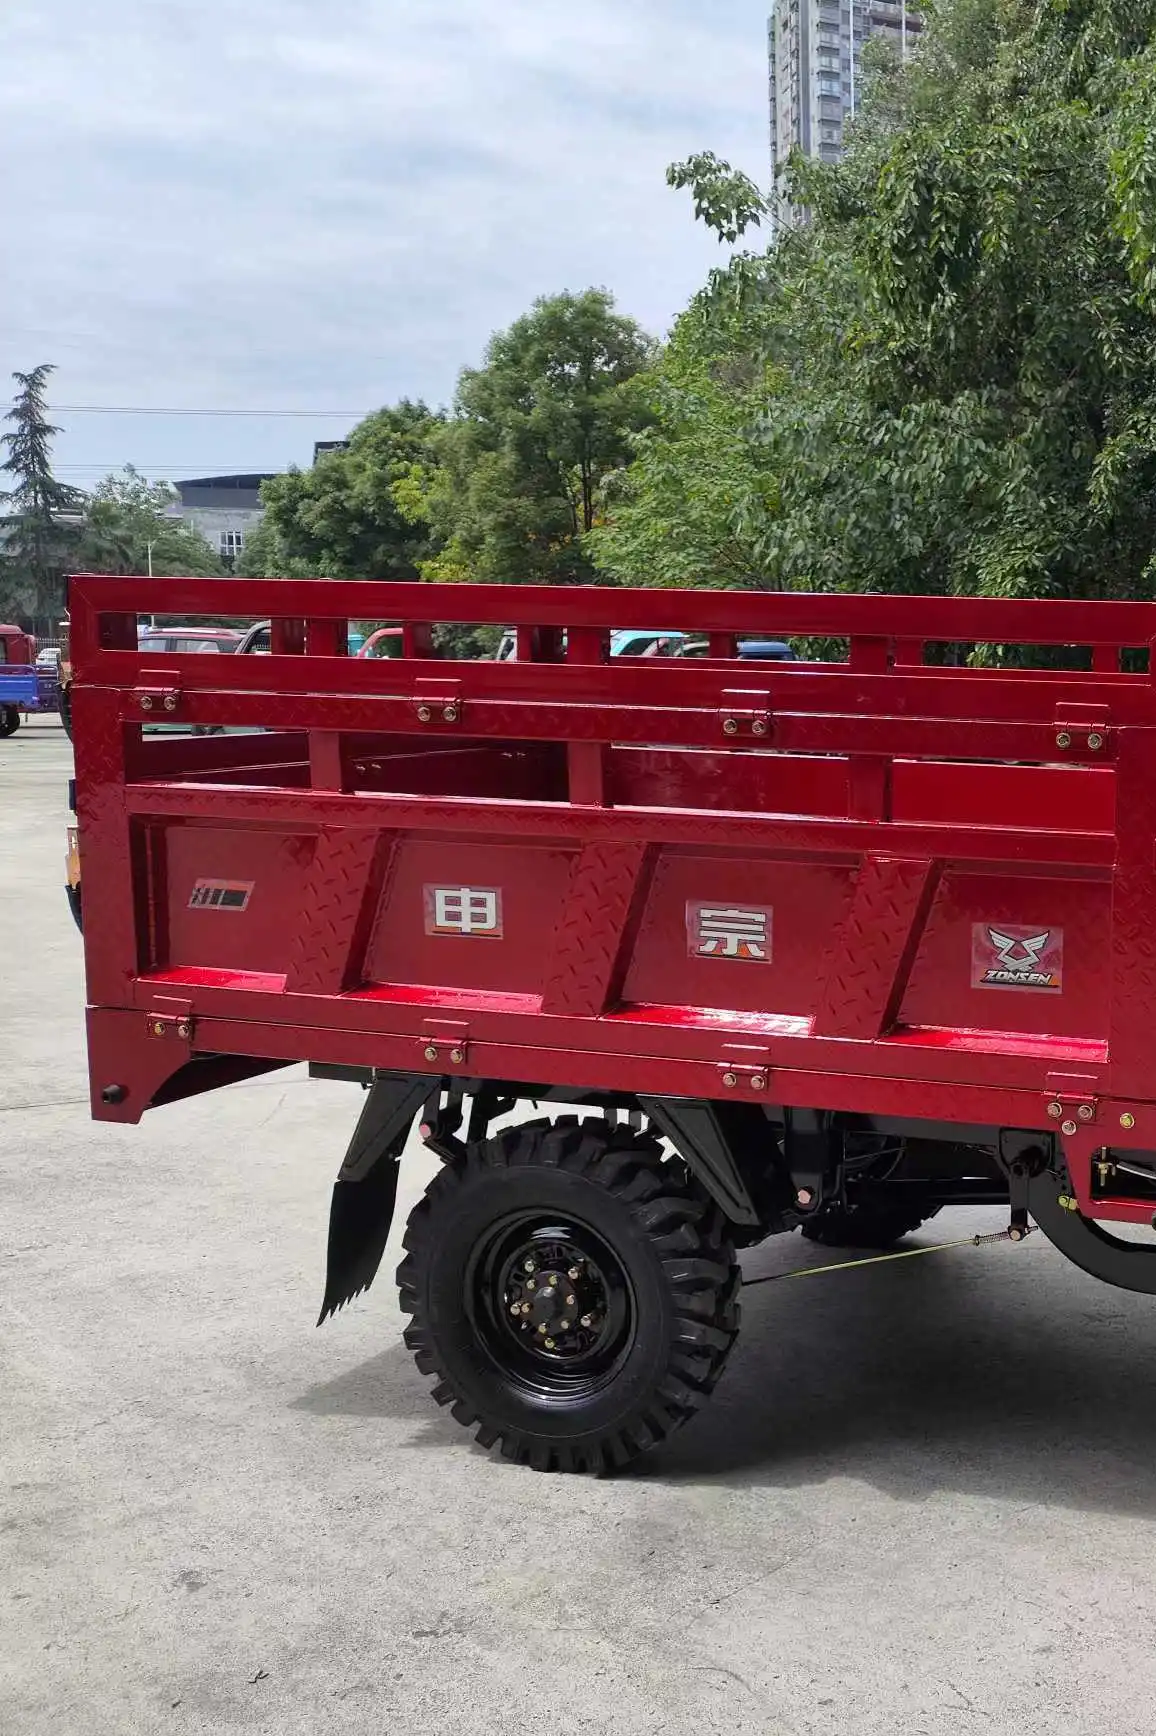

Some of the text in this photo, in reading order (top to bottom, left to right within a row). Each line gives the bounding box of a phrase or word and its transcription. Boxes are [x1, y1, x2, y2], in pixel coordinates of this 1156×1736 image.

[435, 887, 497, 933] 申
[699, 908, 766, 957] 宗
[985, 970, 1052, 985] ZONSEN
